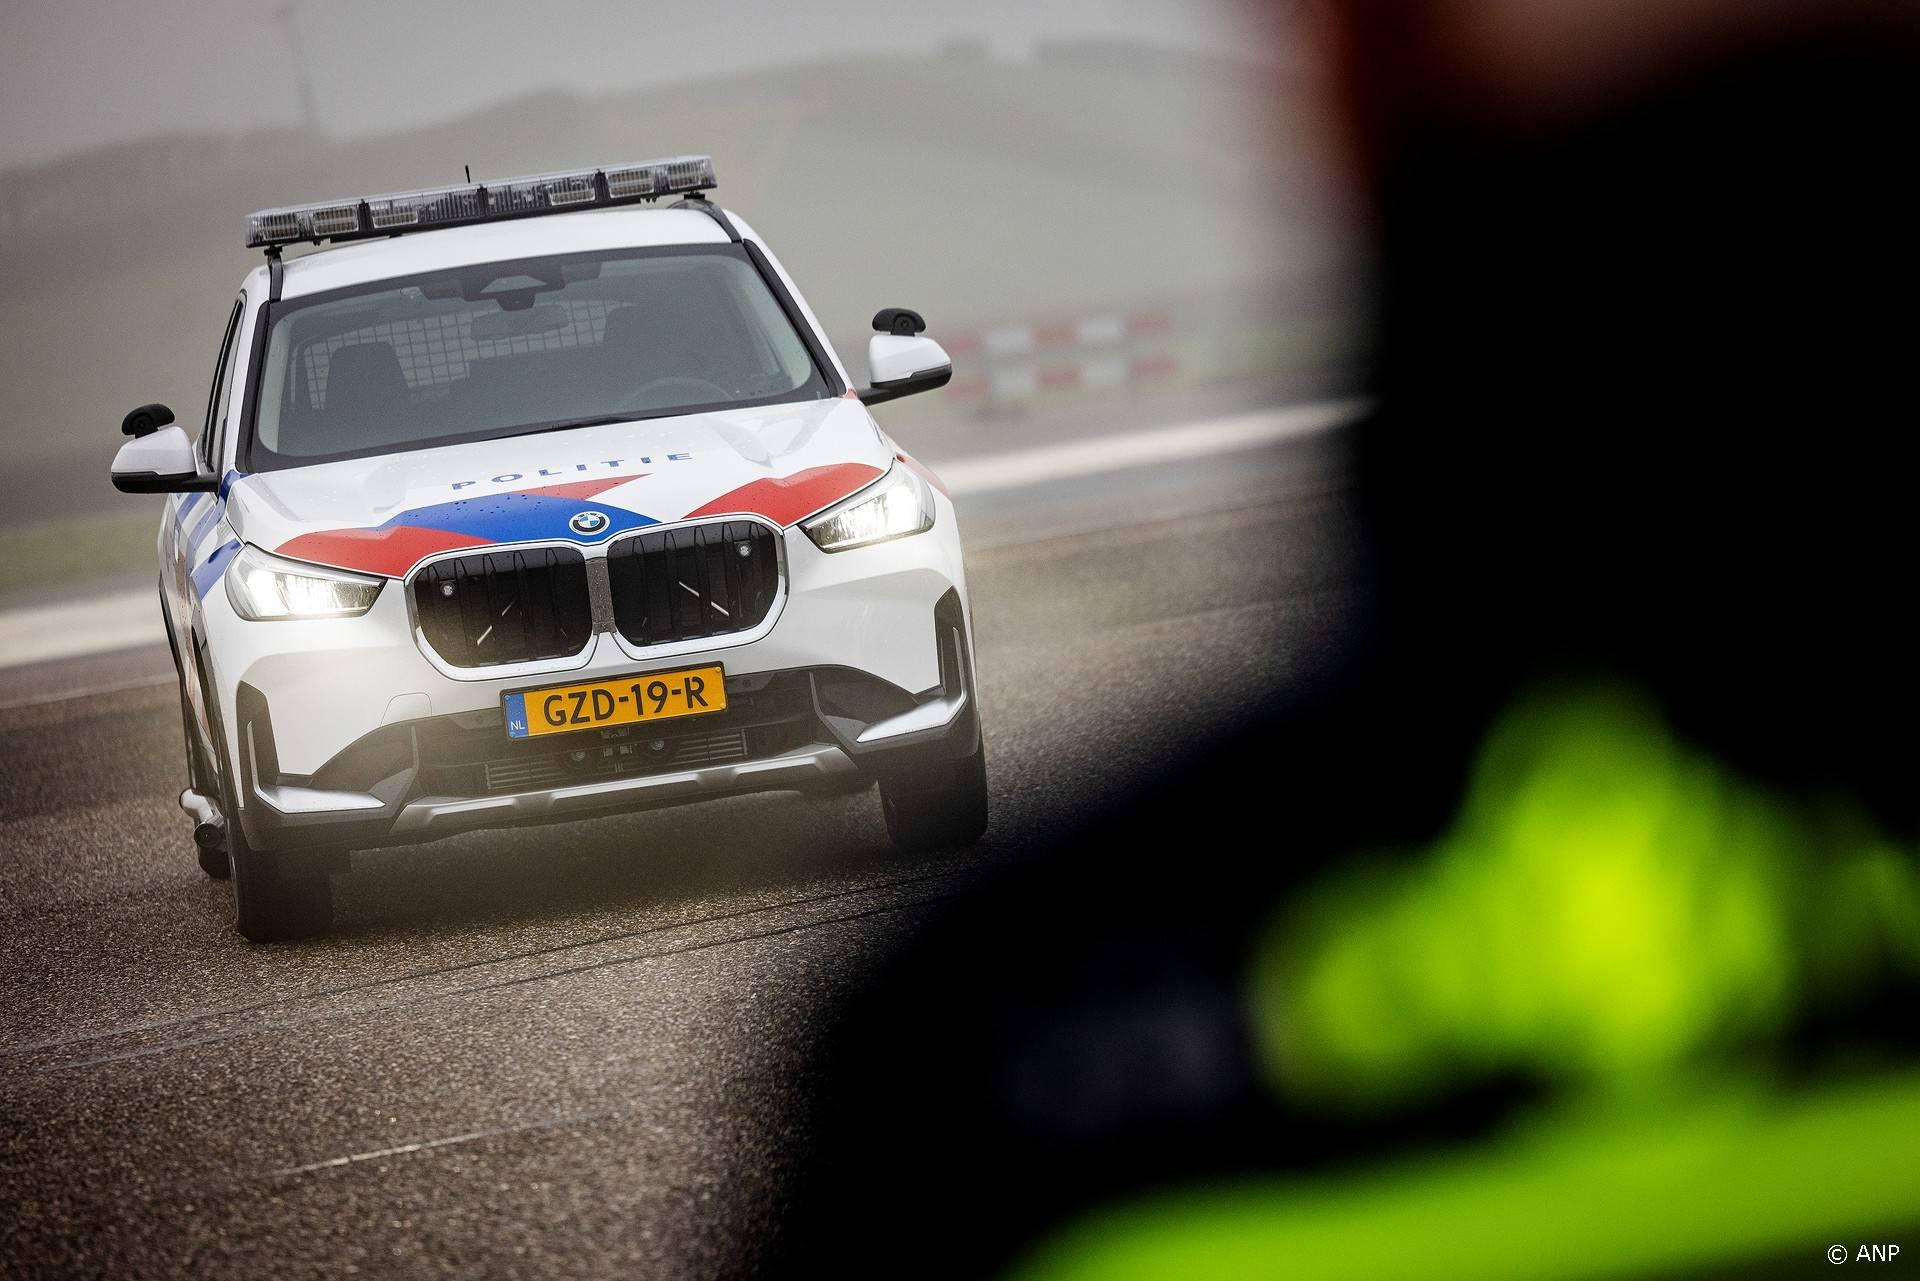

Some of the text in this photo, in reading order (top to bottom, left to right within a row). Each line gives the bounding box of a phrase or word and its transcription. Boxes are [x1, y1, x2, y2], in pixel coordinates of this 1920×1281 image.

[451, 452, 693, 490] POLITIE
[543, 676, 709, 727] GZD-19-R
[510, 719, 526, 731] NL
